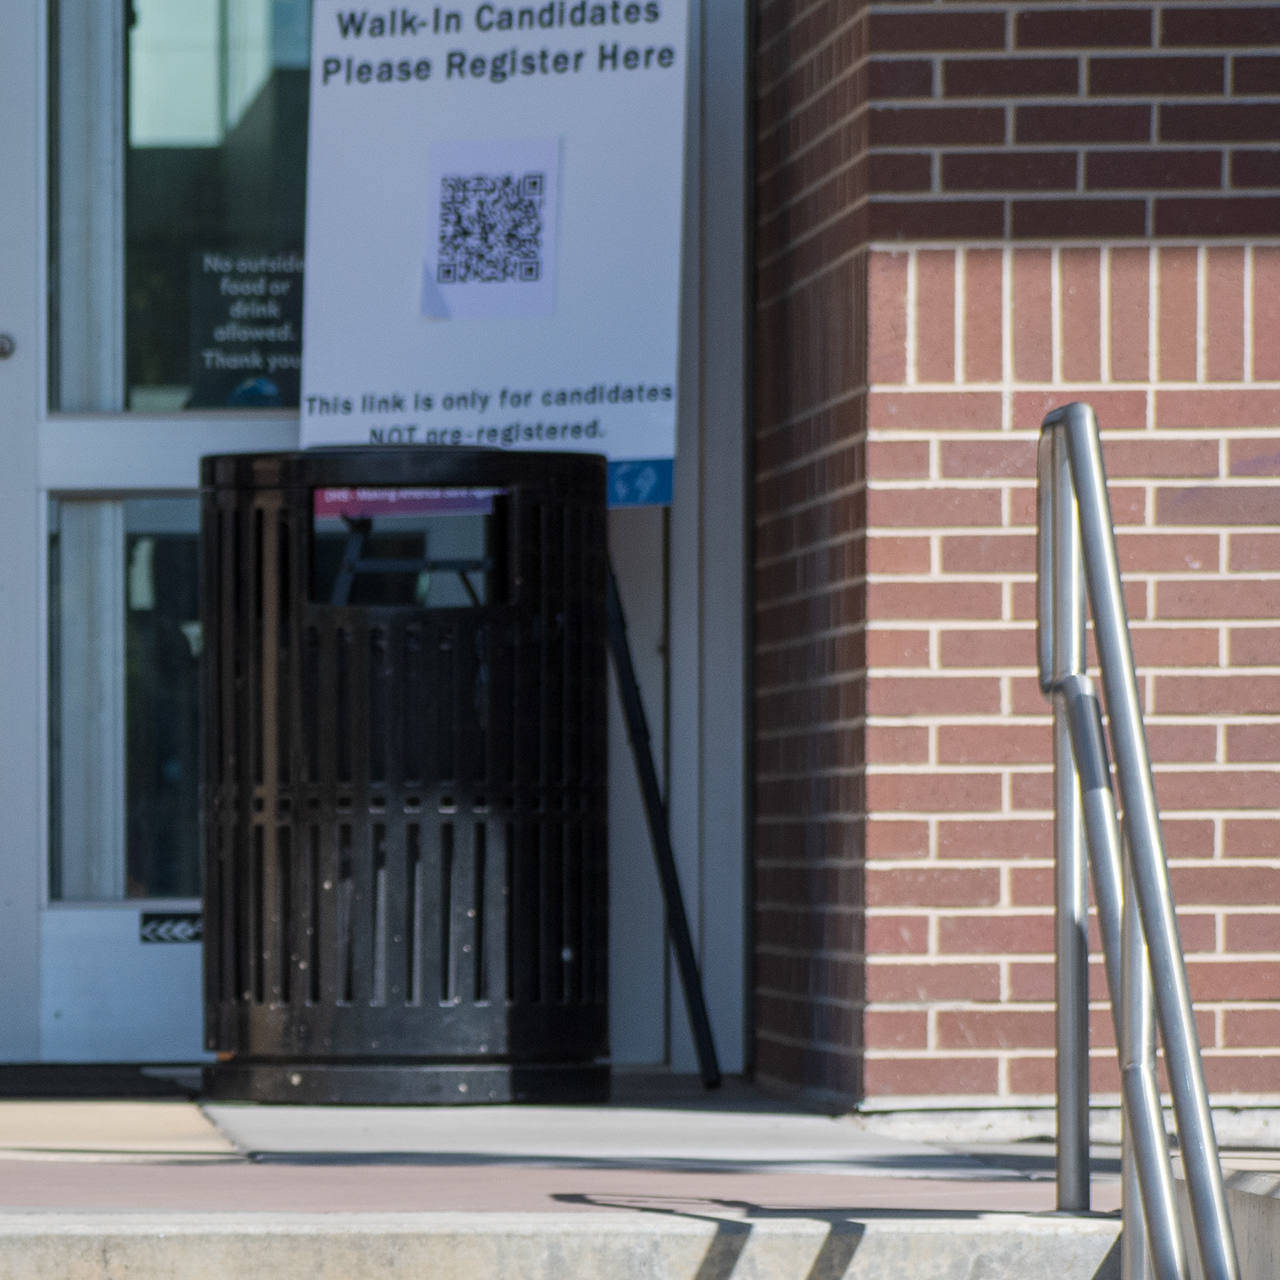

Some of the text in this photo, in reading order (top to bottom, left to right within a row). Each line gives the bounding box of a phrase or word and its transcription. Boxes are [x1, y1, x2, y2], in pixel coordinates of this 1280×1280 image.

[337, 0, 661, 39] Walk-In Candidates
[322, 43, 675, 86] Please Register Here
[203, 253, 232, 273] No
[220, 275, 291, 296] food or
[229, 299, 279, 319] drink
[202, 348, 264, 370] Thank
[307, 383, 673, 417] This link is only for candidates
[369, 418, 606, 448] NOT pre-registered.
